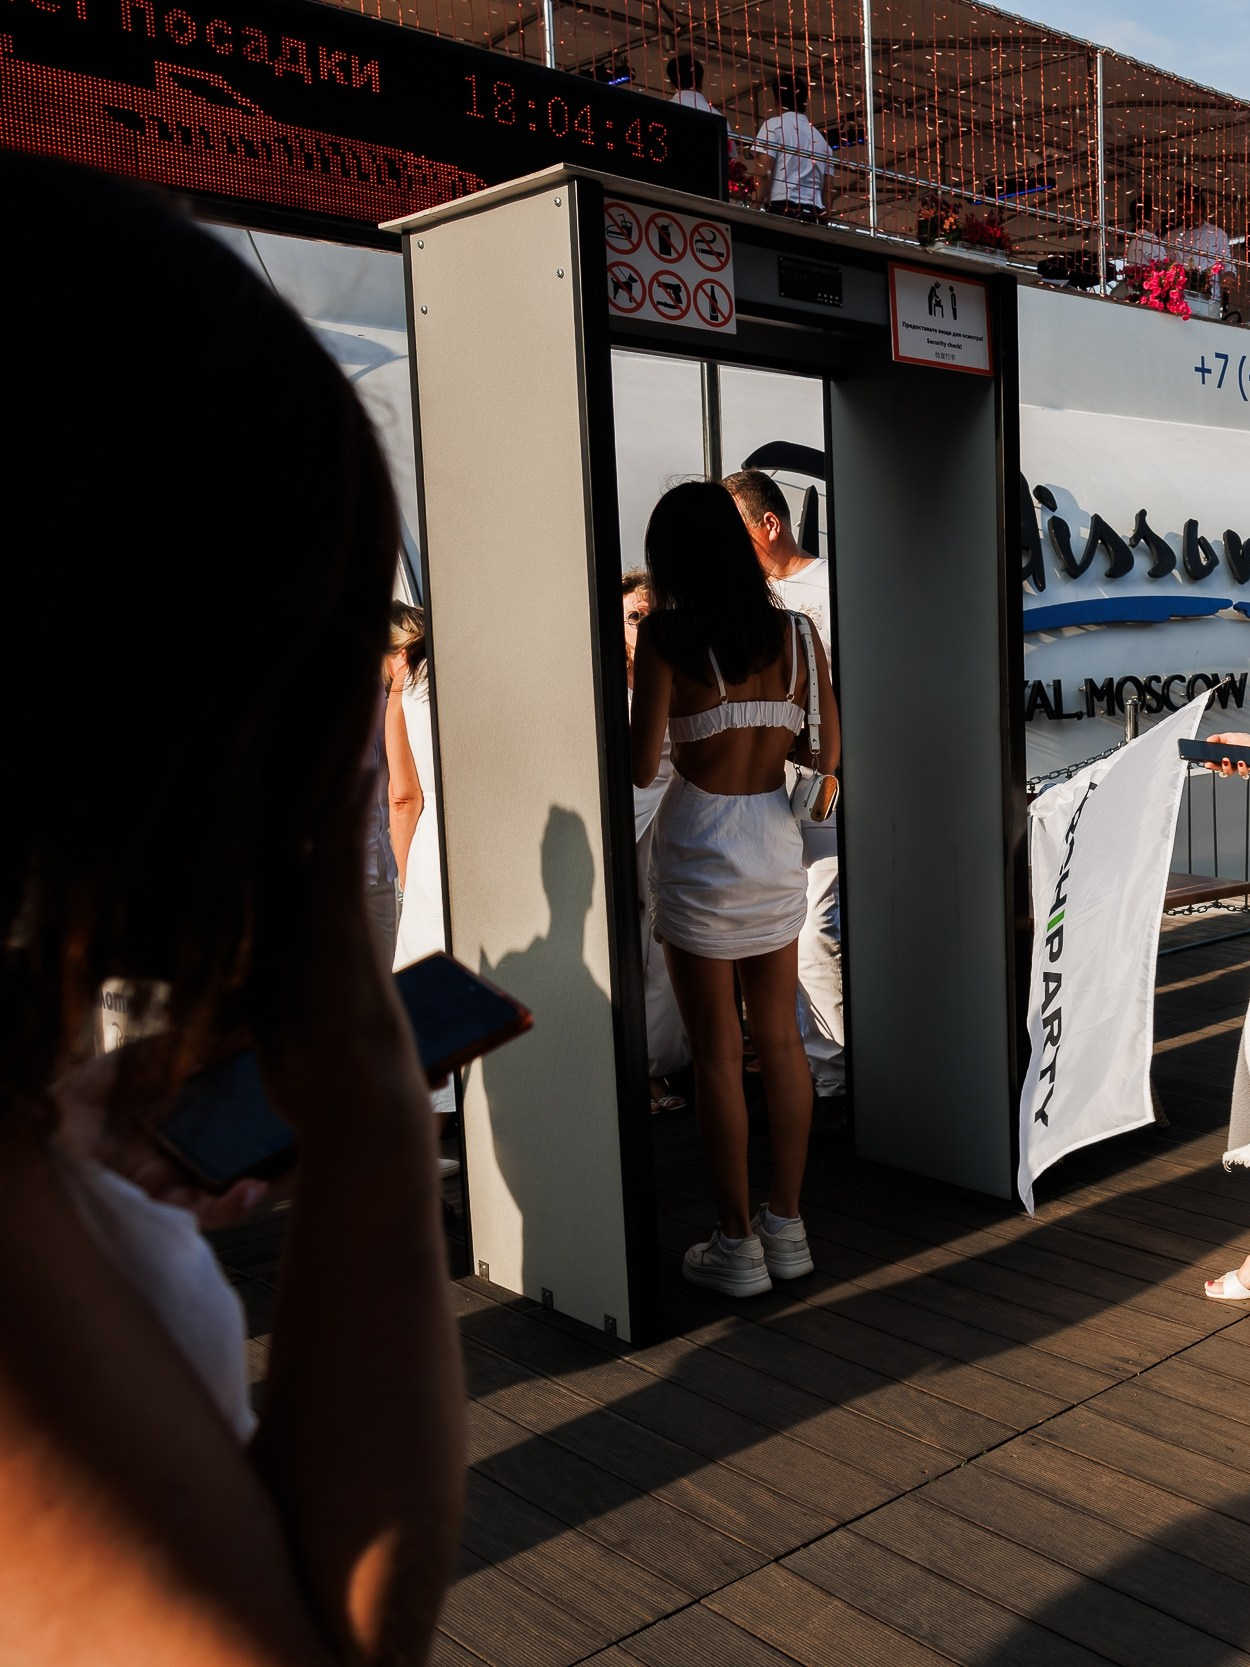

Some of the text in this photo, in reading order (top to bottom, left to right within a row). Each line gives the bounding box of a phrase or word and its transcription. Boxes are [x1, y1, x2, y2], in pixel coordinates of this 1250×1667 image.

[464, 74, 669, 163] 18:04:43
[926, 338, 947, 348] Security
[1194, 352, 1229, 389] +7
[1025, 672, 1249, 722] AL, MOSCOW
